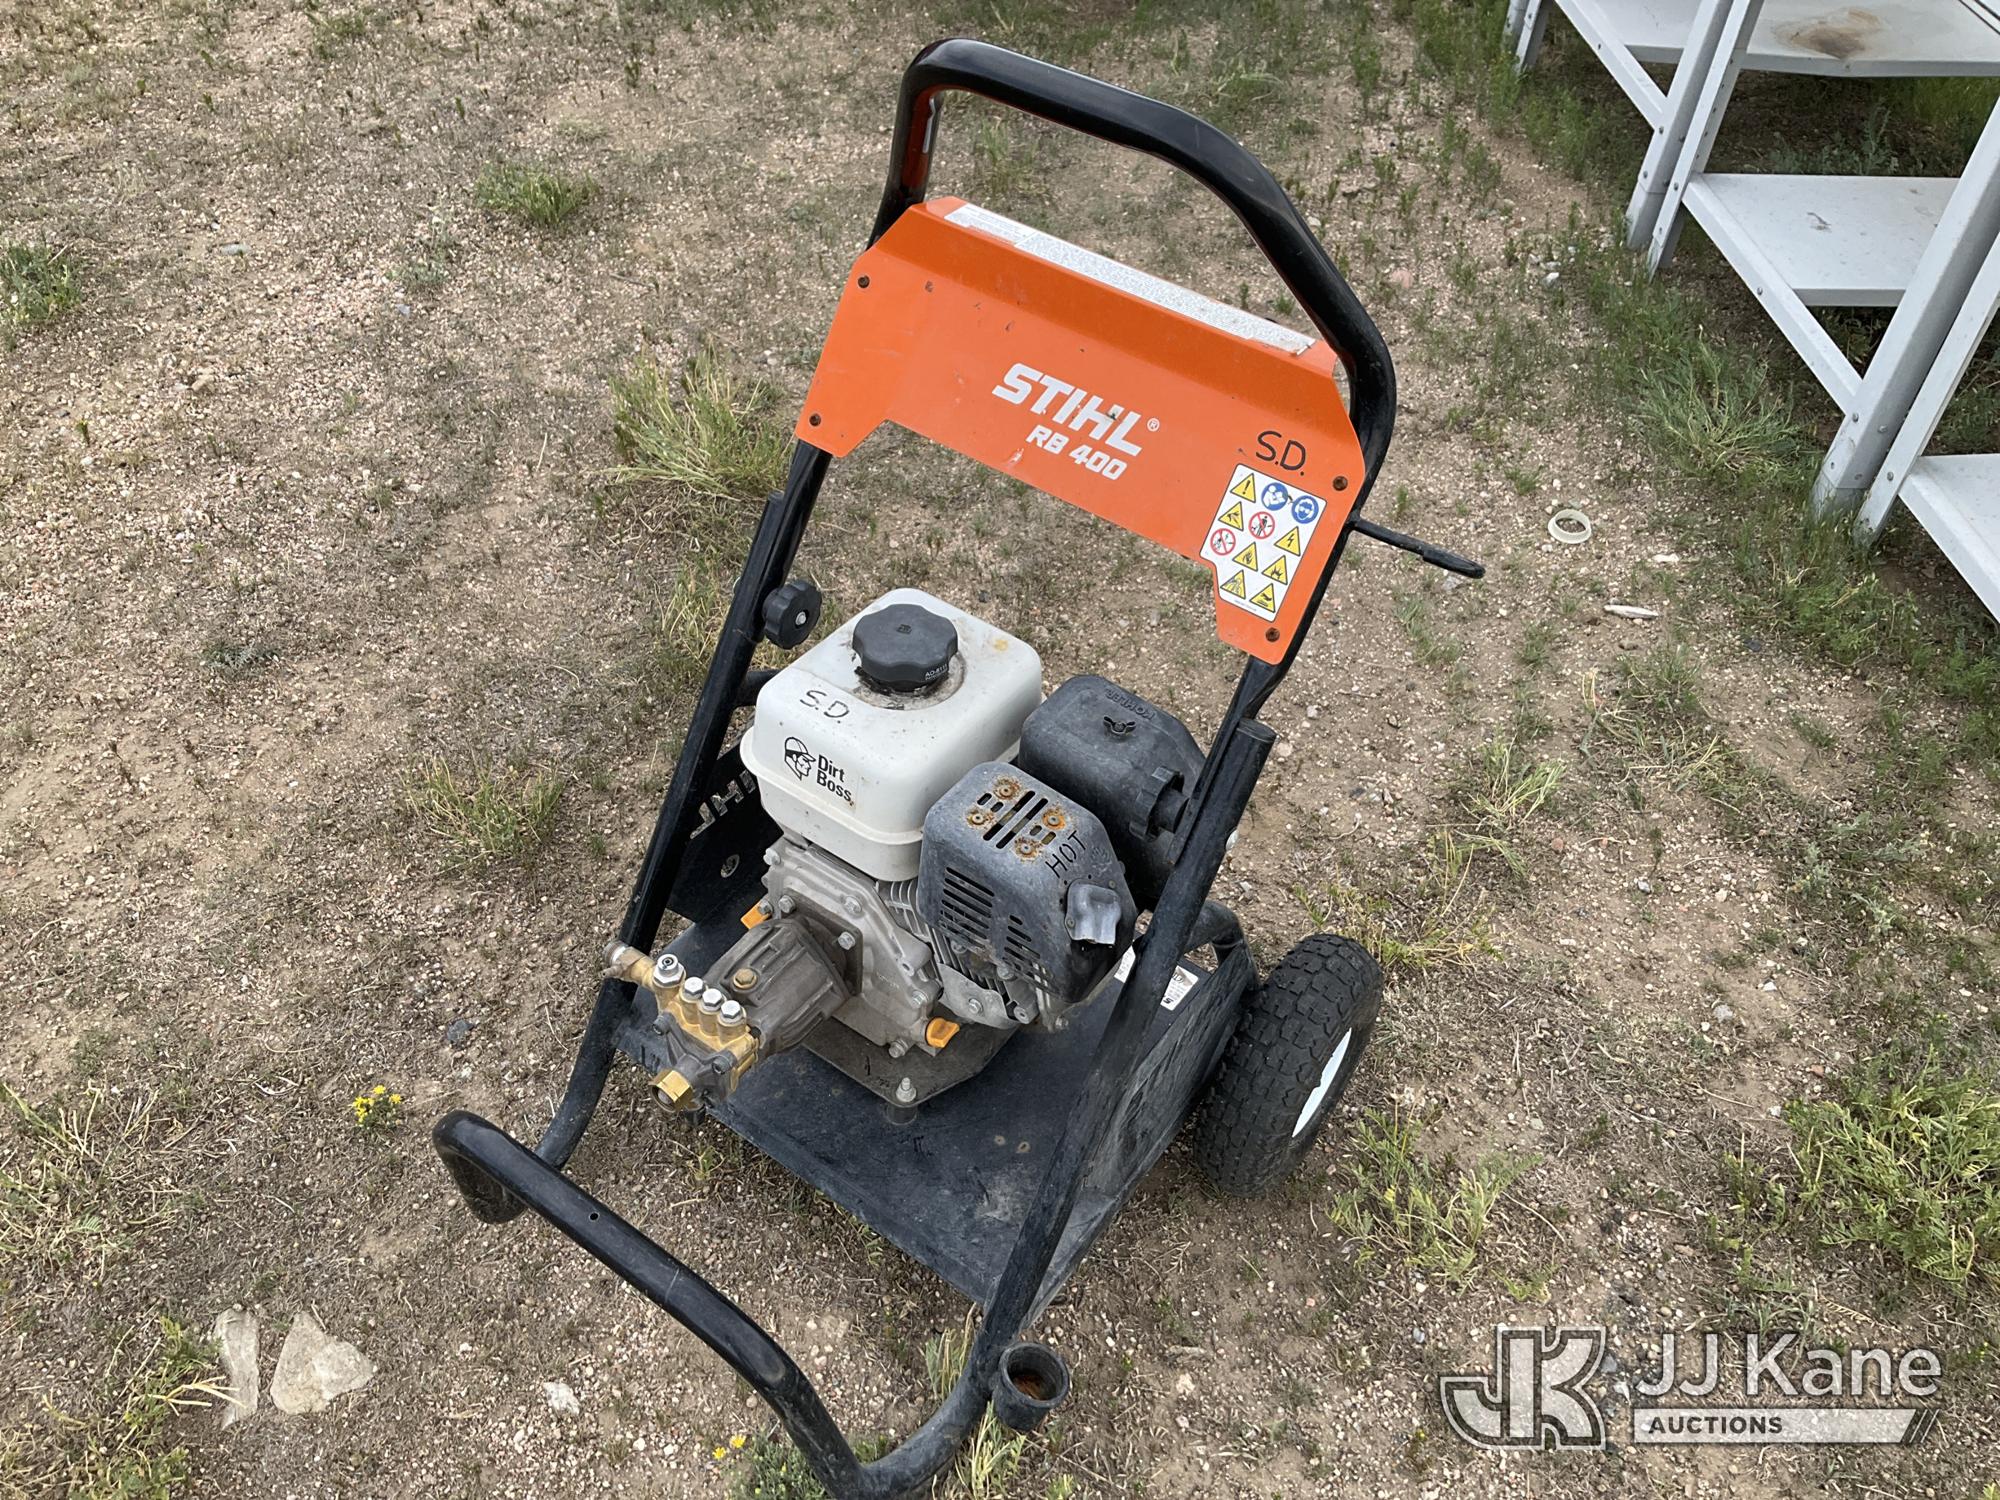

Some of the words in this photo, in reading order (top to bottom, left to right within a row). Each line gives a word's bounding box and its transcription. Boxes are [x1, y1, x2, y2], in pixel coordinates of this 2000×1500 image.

[1026, 423, 1069, 455] RB
[1069, 445, 1127, 481] 400
[816, 769, 852, 802] Boss
[817, 754, 846, 783] Dirt
[1044, 829, 1087, 878] HOT
